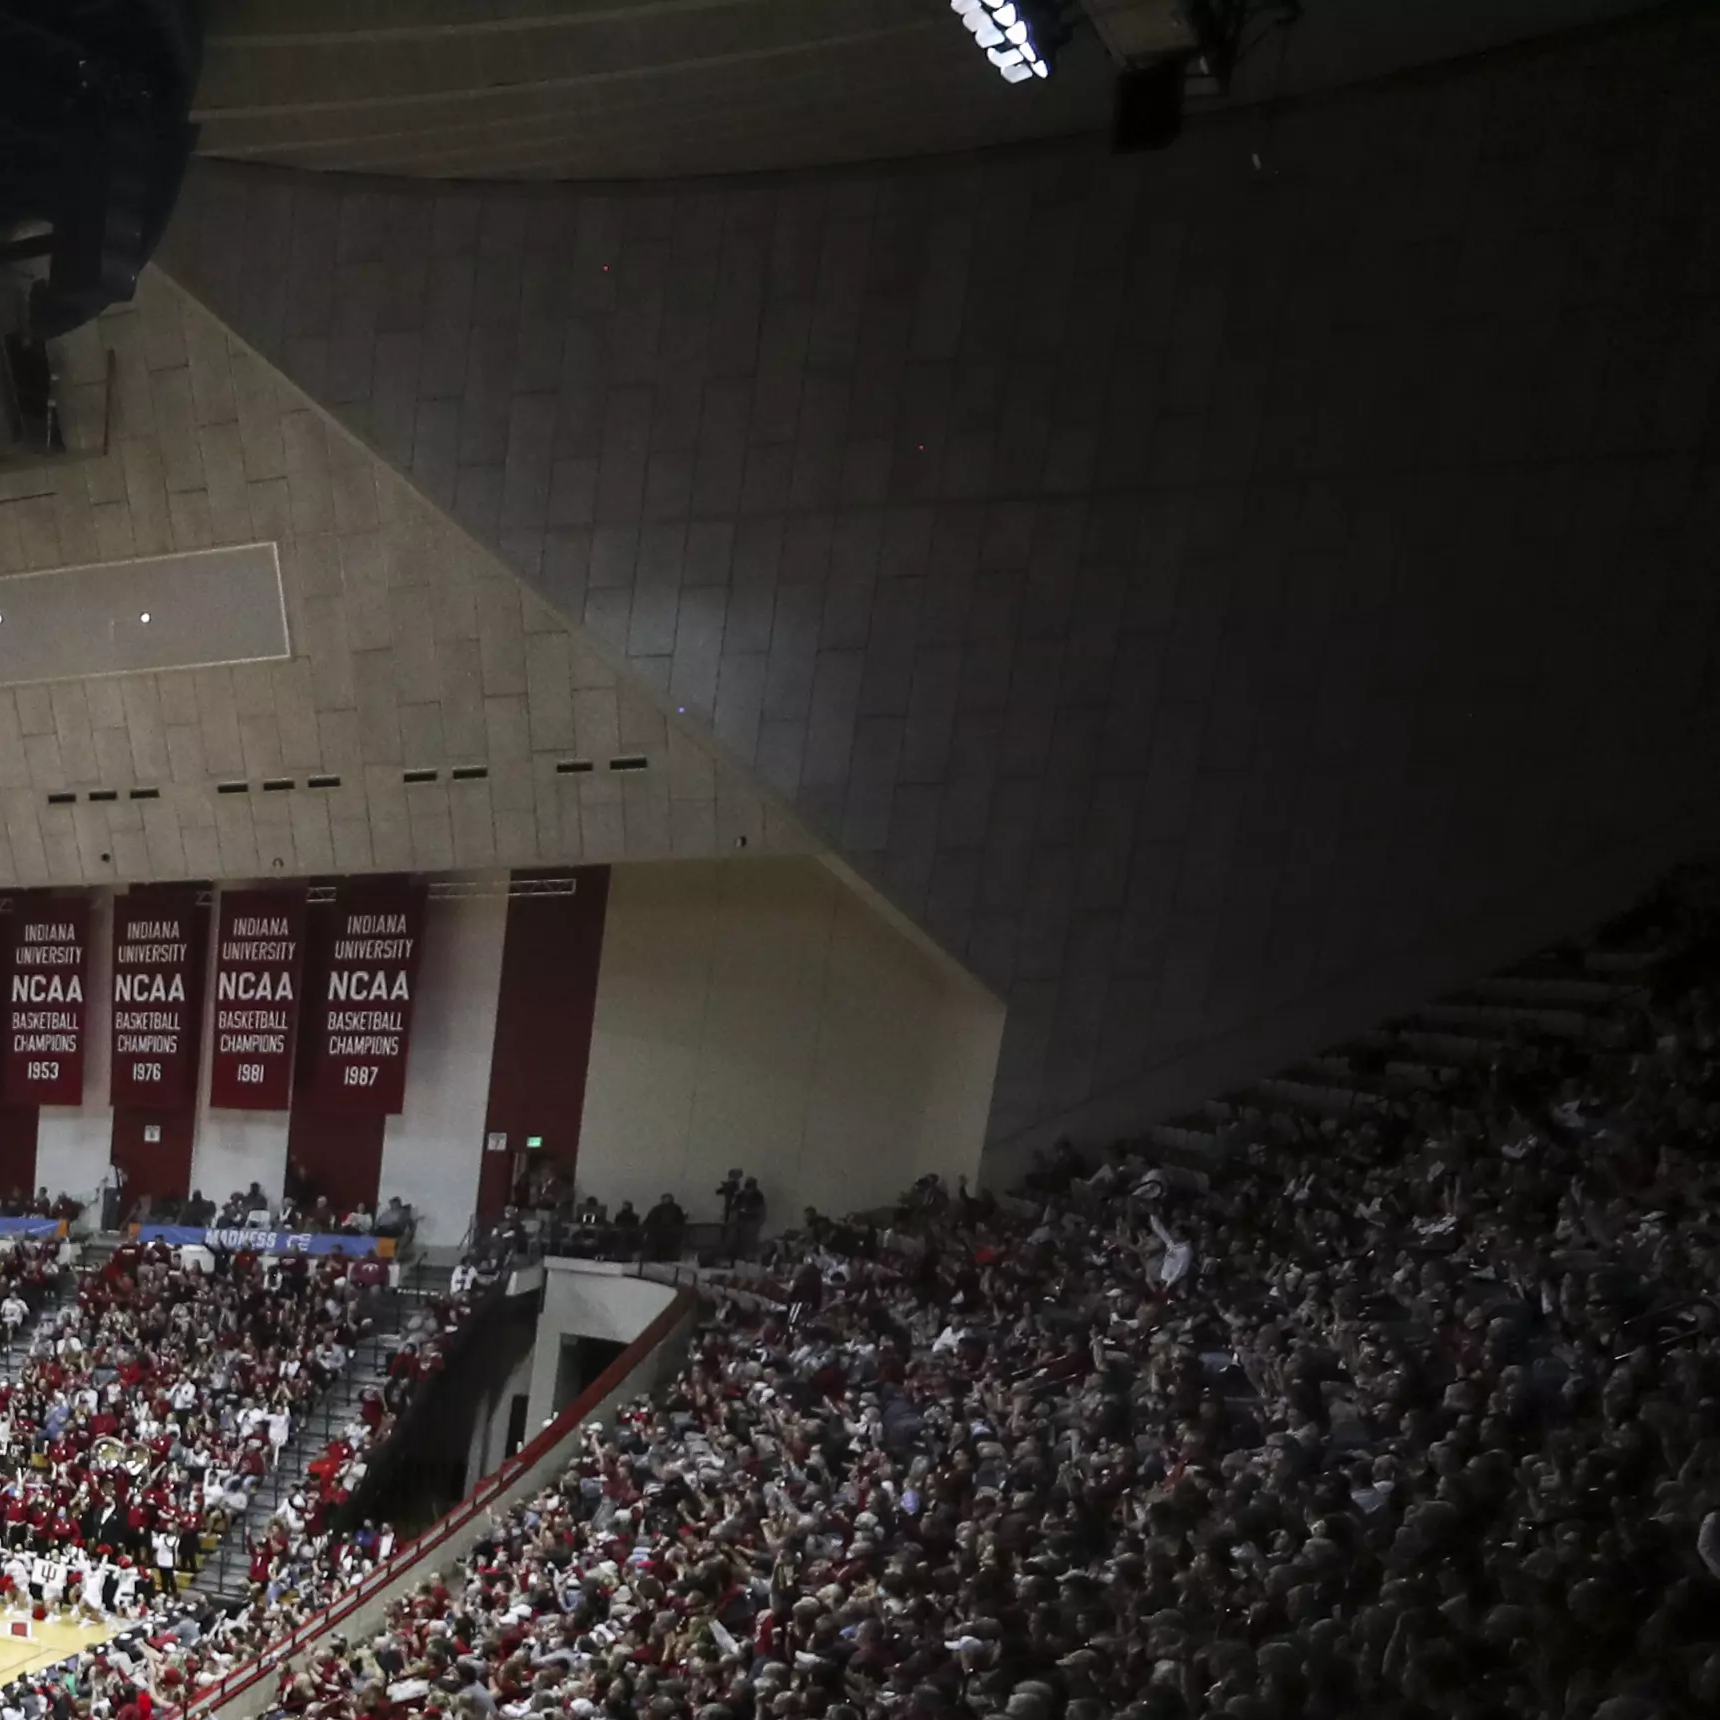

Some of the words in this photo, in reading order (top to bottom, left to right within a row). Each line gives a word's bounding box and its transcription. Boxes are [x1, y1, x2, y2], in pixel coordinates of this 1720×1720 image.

[25, 923, 75, 942] INDIANA
[127, 921, 180, 940] INDIANA
[233, 918, 289, 936] INDIANA
[347, 914, 407, 934] INDIANA
[16, 947, 82, 964] UNIVERSITY
[118, 944, 187, 963] UNIVERSITY
[222, 942, 296, 960] UNIVERSITY
[335, 939, 413, 960] UNIVERSITY
[12, 974, 83, 1002] NCAA
[115, 973, 185, 1002] NCAA
[218, 972, 293, 1000] NCAA
[328, 971, 409, 1001] NCAA
[12, 1012, 79, 1029] BASKETBALL
[115, 1012, 181, 1030] BASKETBALL
[218, 1011, 288, 1029] BASKETBALL
[327, 1012, 403, 1031] BASKETBALL
[14, 1035, 76, 1052] CHAMPIONS
[118, 1035, 177, 1053] CHAMPIONS
[220, 1035, 284, 1053] CHAMPIONS
[329, 1036, 399, 1055] CHAMPIONS
[28, 1062, 59, 1079] 1953
[133, 1063, 161, 1081] 1976
[237, 1064, 264, 1082] 1981
[344, 1067, 379, 1086] 1987
[205, 1229, 277, 1249] MADNESS
